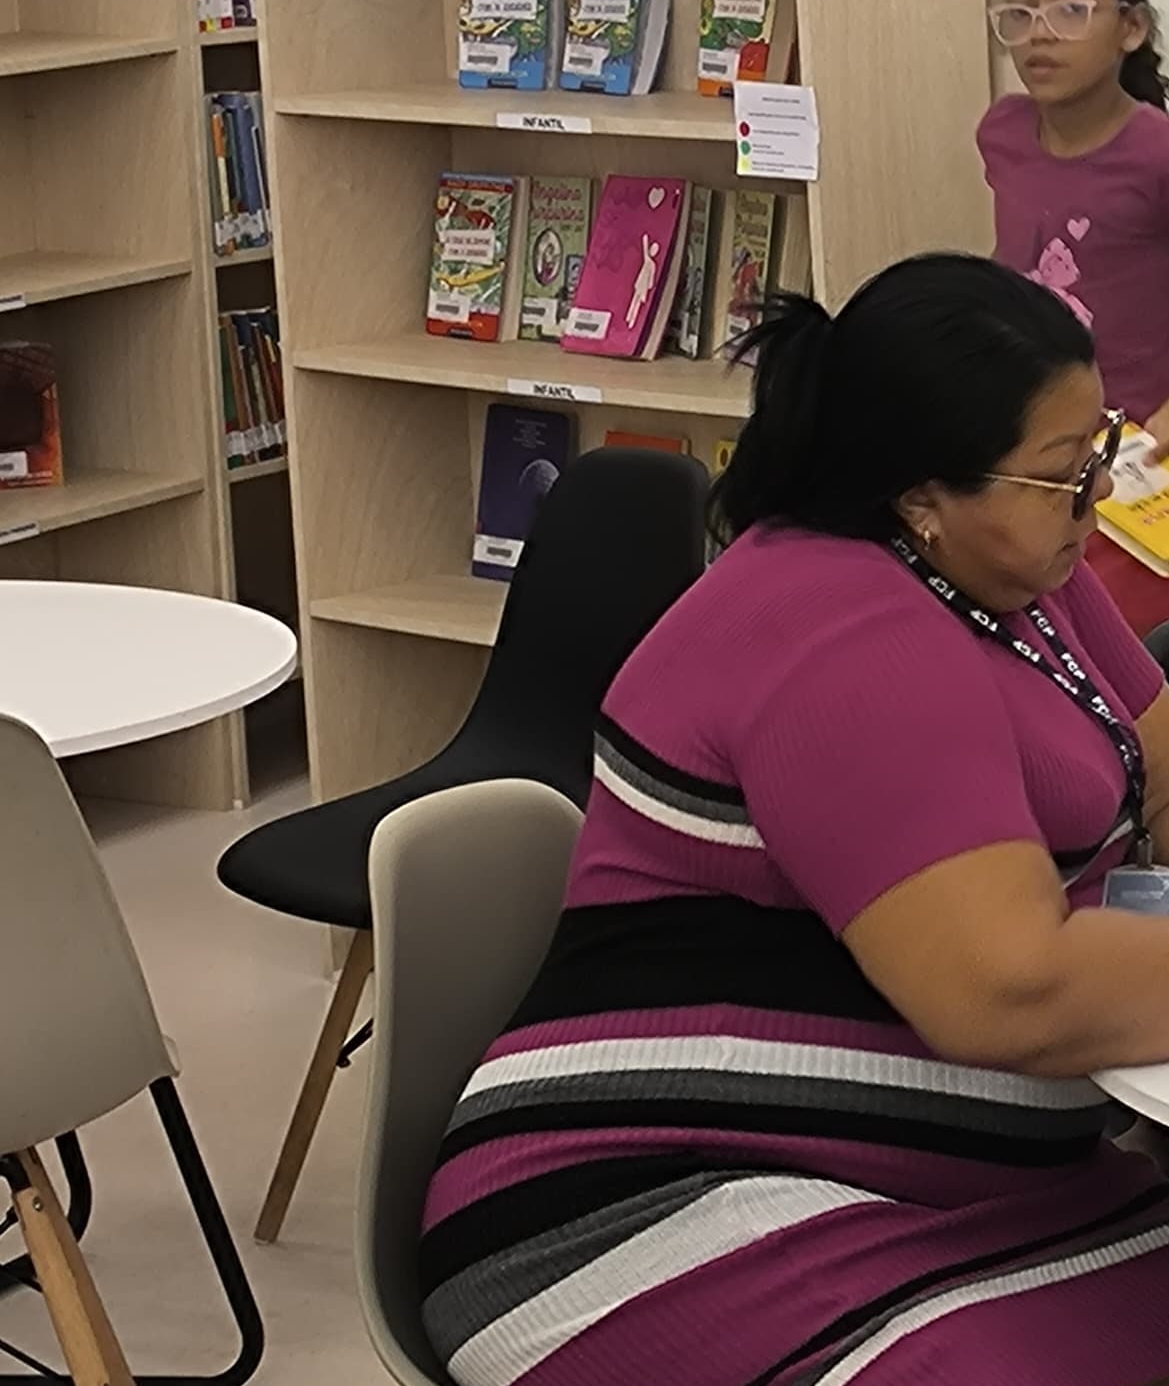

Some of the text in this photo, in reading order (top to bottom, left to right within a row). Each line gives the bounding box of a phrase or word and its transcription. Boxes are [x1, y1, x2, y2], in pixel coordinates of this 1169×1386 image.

[522, 117, 565, 131] INFANTIL
[927, 575, 956, 601] FCP
[1030, 608, 1057, 638] FCP
[1060, 651, 1088, 681] FCP
